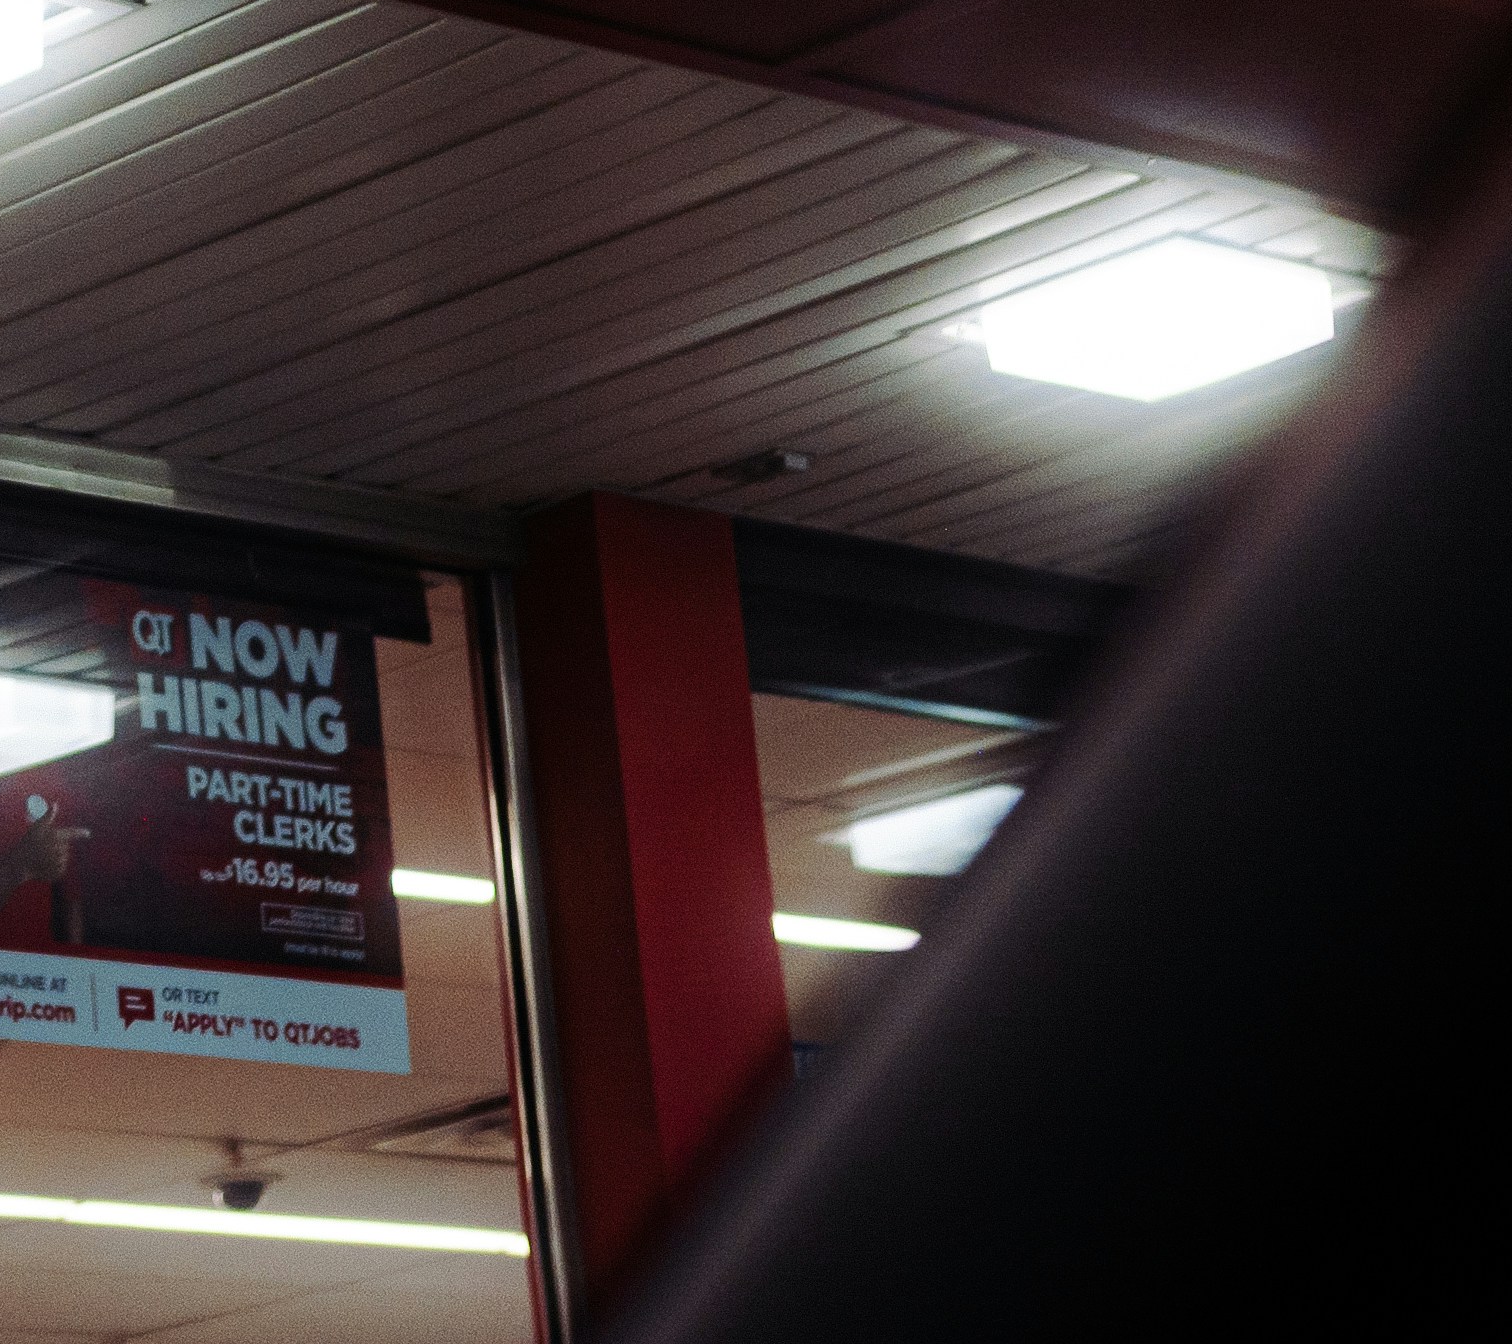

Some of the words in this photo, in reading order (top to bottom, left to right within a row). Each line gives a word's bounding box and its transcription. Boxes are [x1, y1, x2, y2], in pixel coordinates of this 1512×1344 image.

[132, 610, 173, 656] QT
[190, 613, 337, 687] NOW
[137, 672, 347, 754] HIRING
[187, 765, 353, 817] PART-TIME
[233, 810, 357, 855] CLERKS
[49, 977, 68, 993] AT
[162, 987, 183, 1002] OR
[185, 988, 220, 1006] TEXT
[250, 1017, 279, 1041] TO
[284, 1021, 362, 1050] QTJOBS
